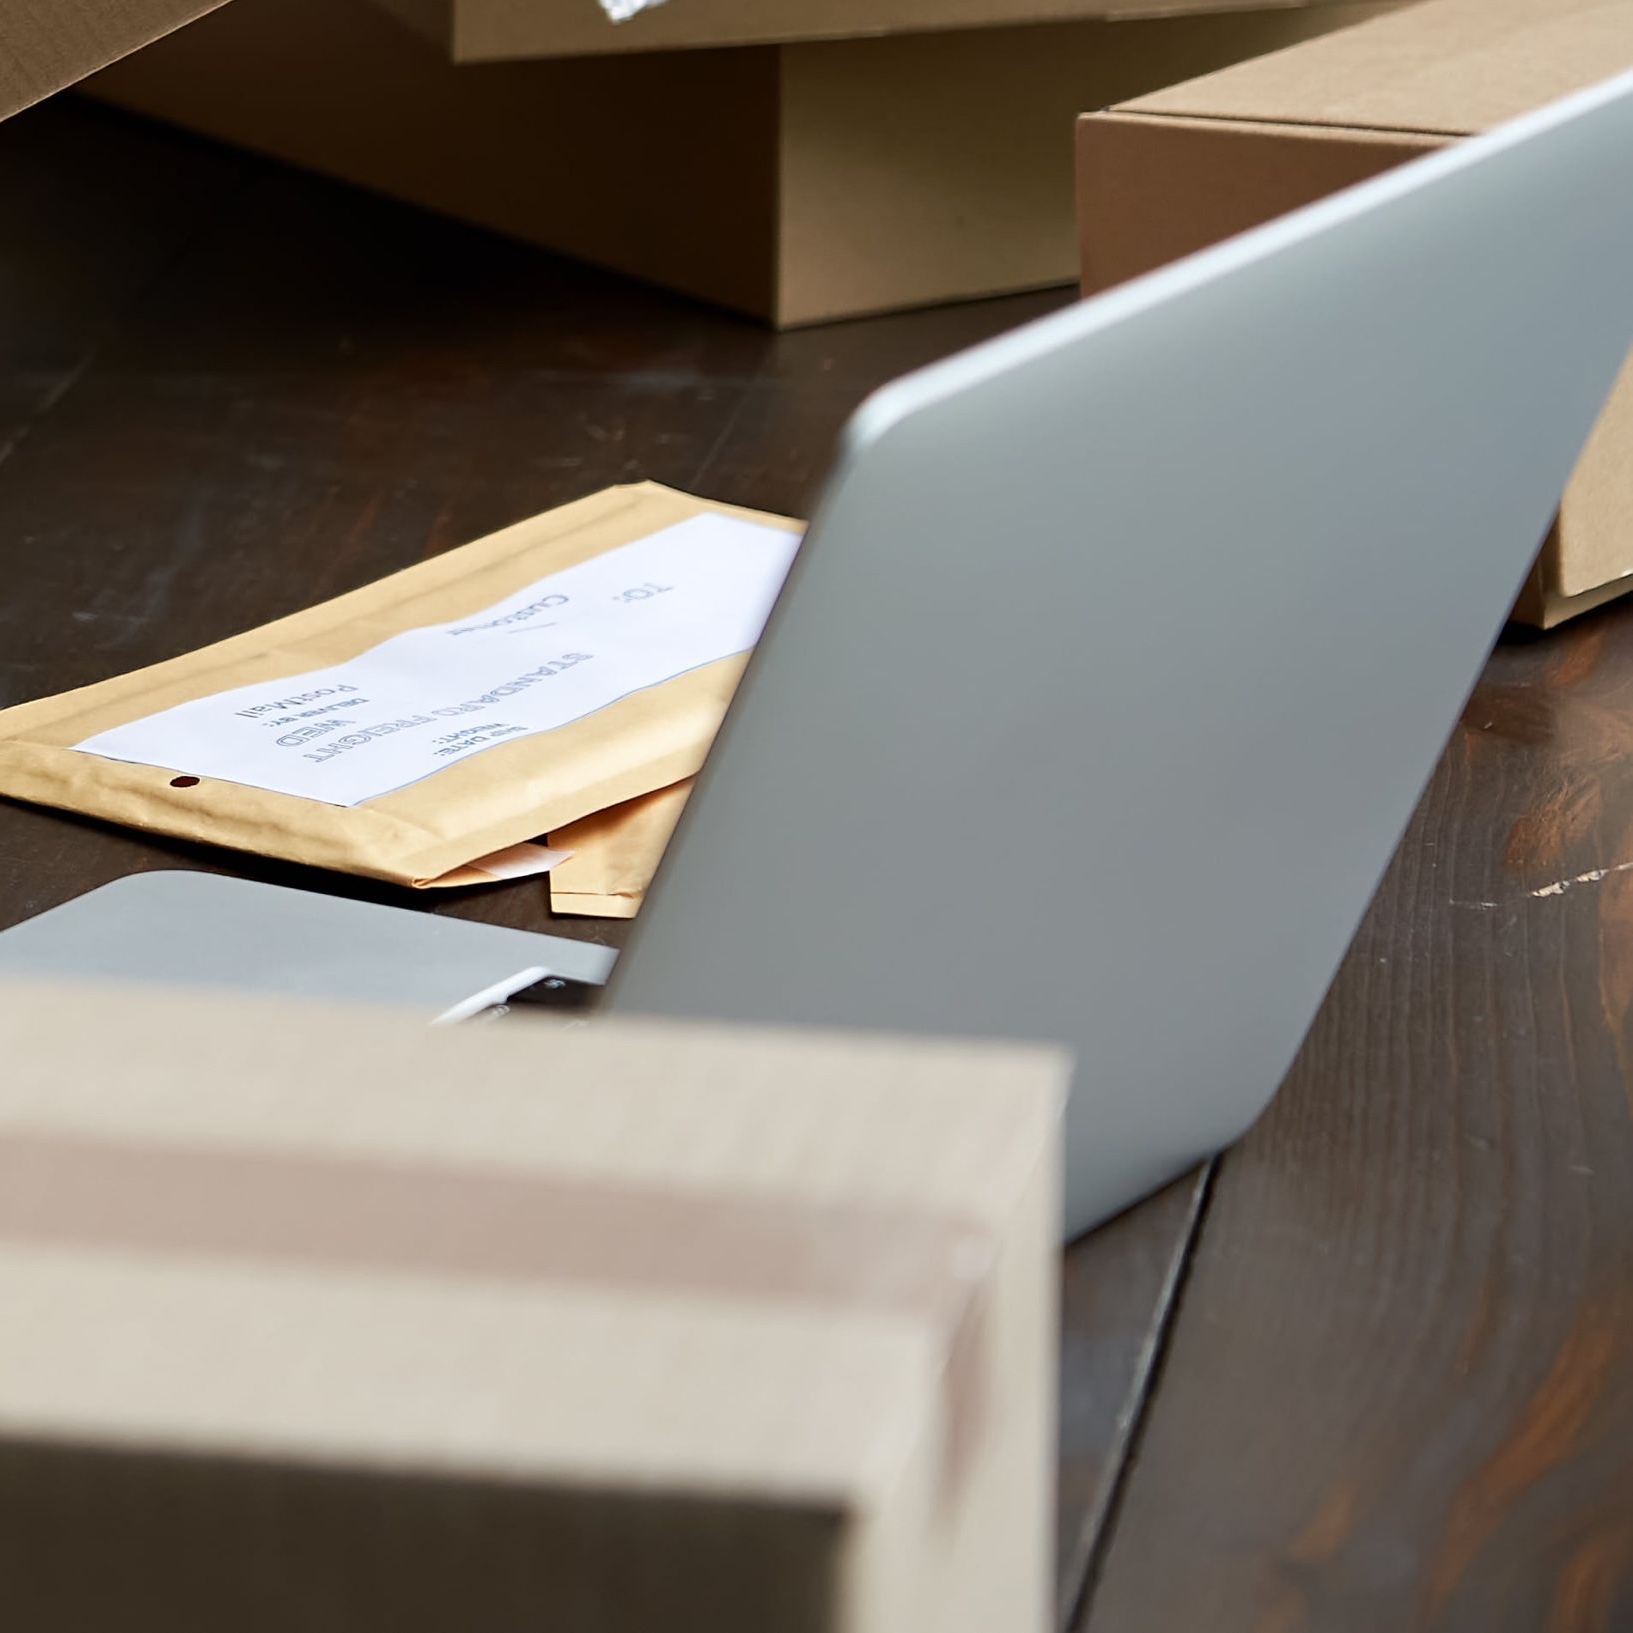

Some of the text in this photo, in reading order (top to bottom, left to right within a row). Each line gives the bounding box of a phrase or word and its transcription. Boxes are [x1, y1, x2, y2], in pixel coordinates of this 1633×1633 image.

[612, 582, 674, 603] TO:
[447, 594, 569, 636] Customer
[234, 684, 359, 719] PostMail
[302, 652, 594, 763] STANDARD FREIGHT
[263, 712, 297, 727] BY:
[275, 719, 356, 747] WED
[431, 722, 509, 744] WEIGHT:
[433, 736, 489, 756] DATE:
